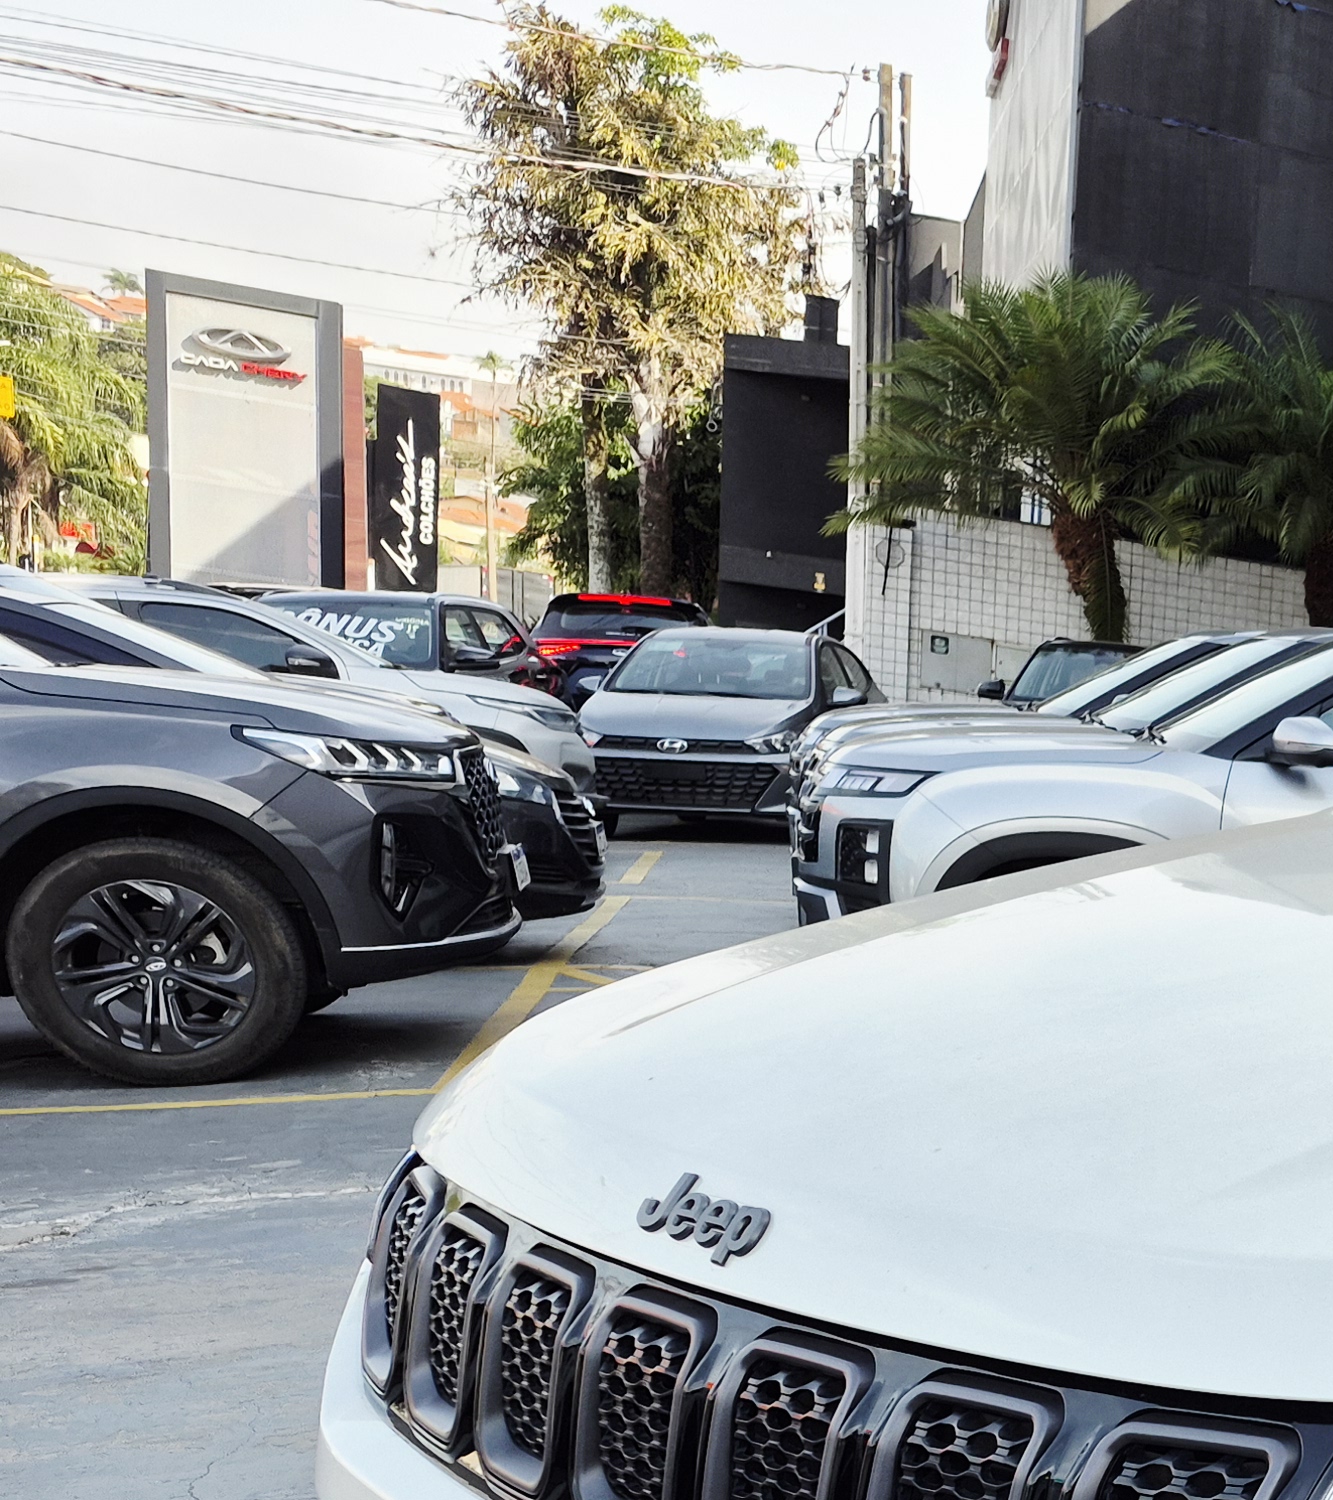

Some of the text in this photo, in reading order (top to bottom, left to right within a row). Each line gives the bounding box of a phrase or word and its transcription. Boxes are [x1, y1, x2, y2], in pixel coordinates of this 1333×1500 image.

[241, 362, 307, 382] CHERY
[419, 456, 436, 545] COLCHÕES
[283, 607, 404, 643] ÔNUS
[636, 1172, 771, 1266] Jeep
